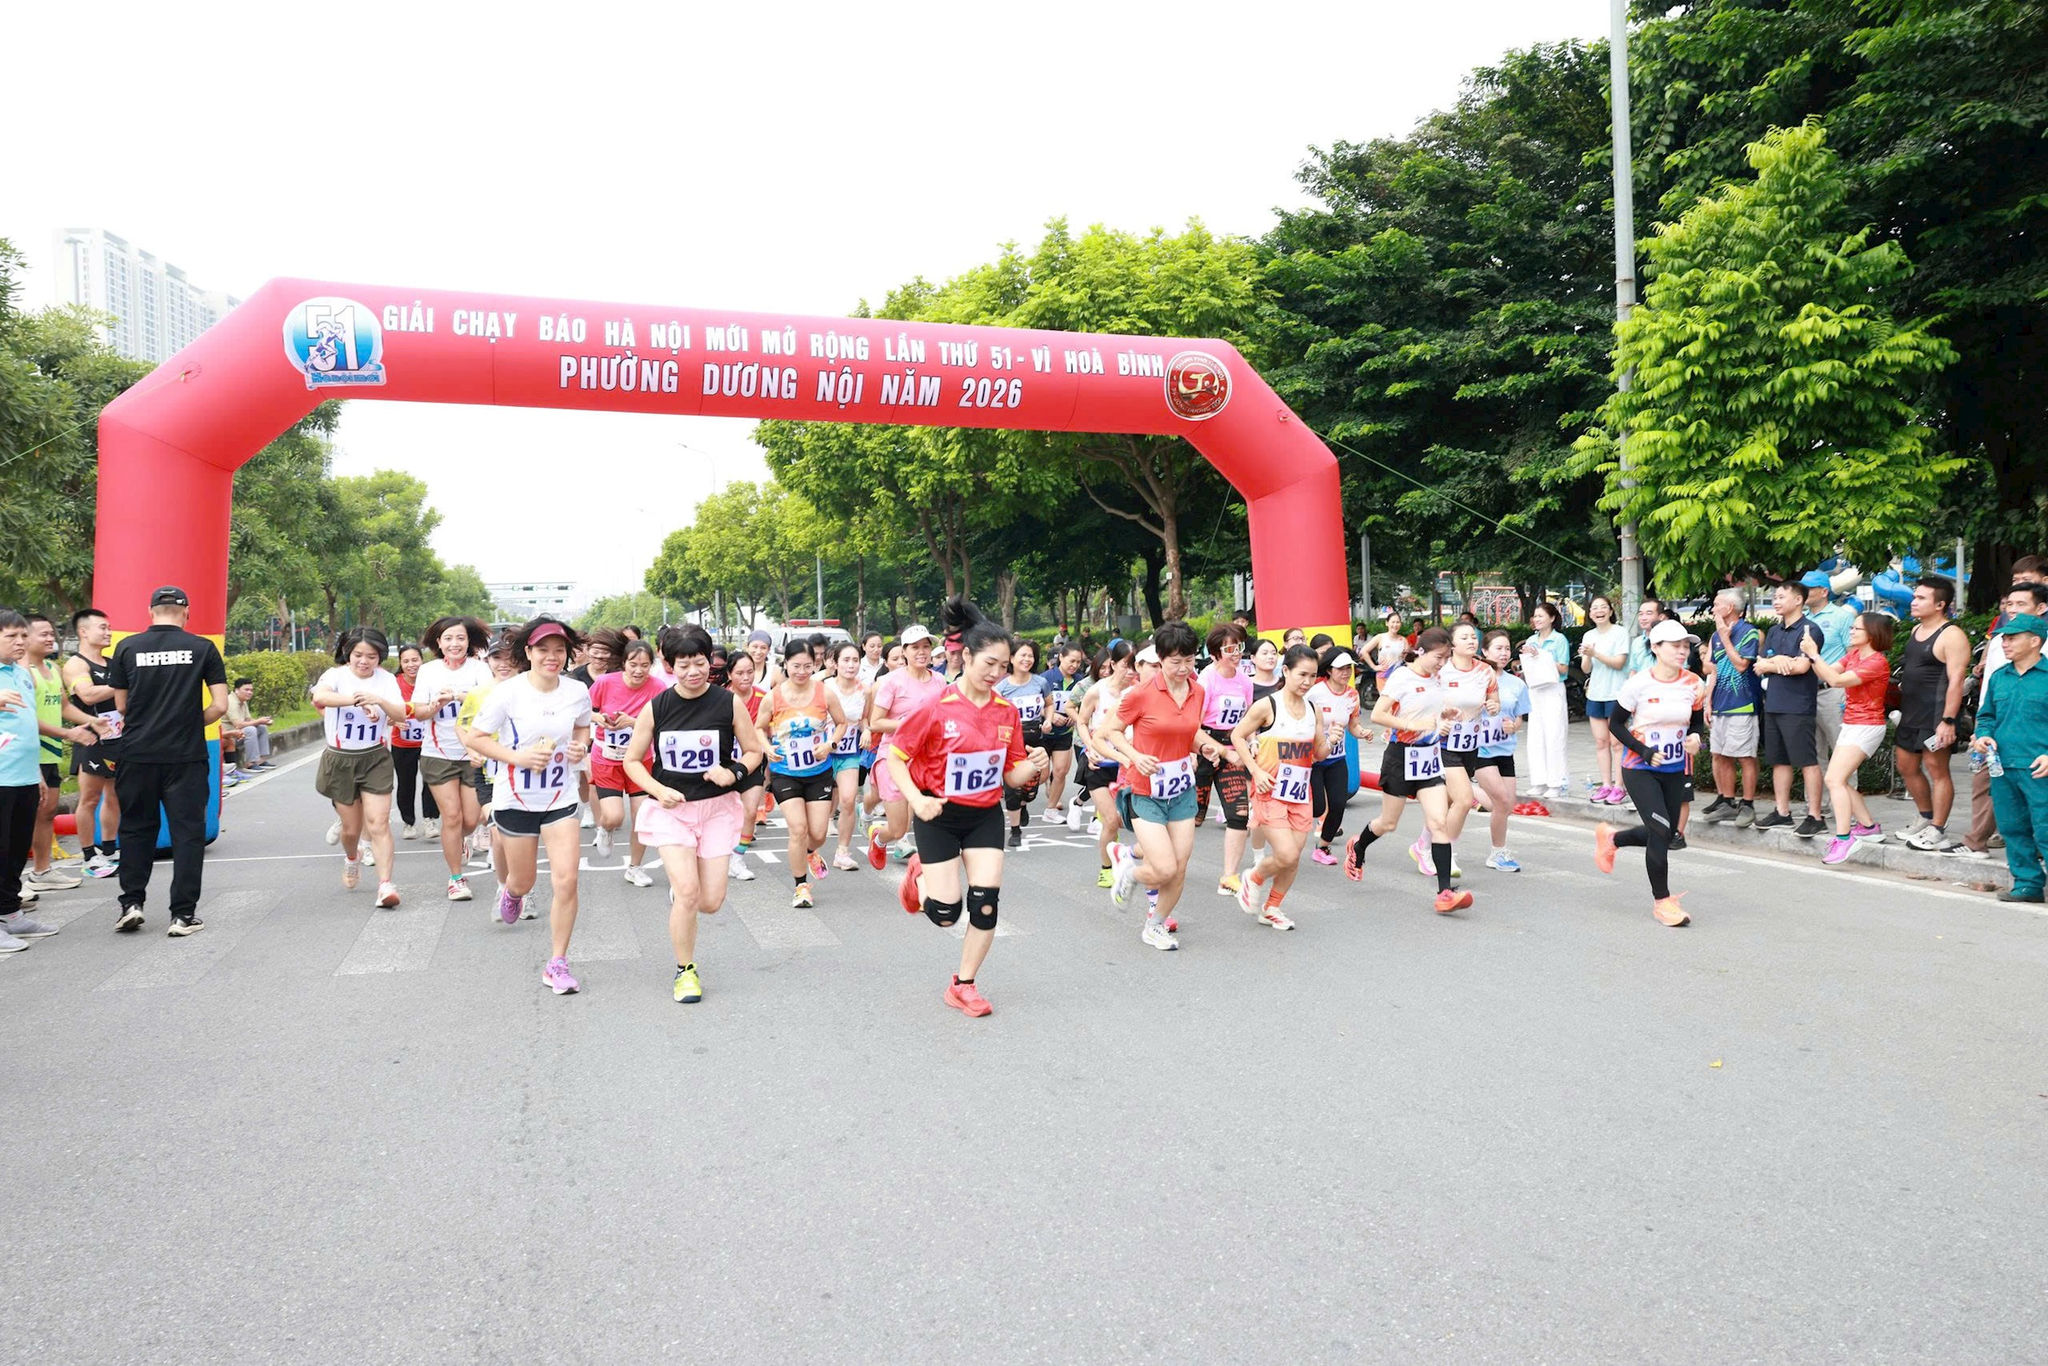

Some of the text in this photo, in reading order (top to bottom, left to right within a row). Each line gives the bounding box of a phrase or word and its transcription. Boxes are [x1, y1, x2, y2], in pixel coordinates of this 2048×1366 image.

[305, 304, 360, 372] 51
[383, 300, 434, 333] GIẢI
[453, 309, 517, 344] CHẠY
[539, 313, 587, 343] BÁO
[604, 317, 636, 347] HÀ
[650, 320, 691, 355] NỘI
[705, 323, 749, 352] MỚI
[761, 325, 797, 356] MỞ
[809, 330, 869, 364] RỘNG
[884, 332, 926, 363] LẦN
[938, 340, 978, 368] THỨ
[1031, 344, 1051, 372] VÌ
[1064, 347, 1105, 375] HOÀ
[1117, 350, 1164, 378] BÌNH
[559, 350, 1023, 409] PHƯỜNG DƯƠNG NỘI NĂM 2026
[136, 651, 193, 667] REFEREE
[438, 702, 462, 718] 11
[343, 723, 378, 741] 111
[404, 727, 424, 740] 13
[608, 733, 632, 746] 12
[1453, 733, 1478, 750] 131
[838, 737, 854, 751] 37
[1330, 741, 1344, 756] 05
[665, 748, 714, 770] 129
[790, 749, 822, 768] 10
[1409, 757, 1440, 777] 149
[520, 765, 563, 790] 112
[951, 766, 999, 791] 162
[1154, 773, 1191, 797] 123
[1279, 779, 1308, 801] 148
